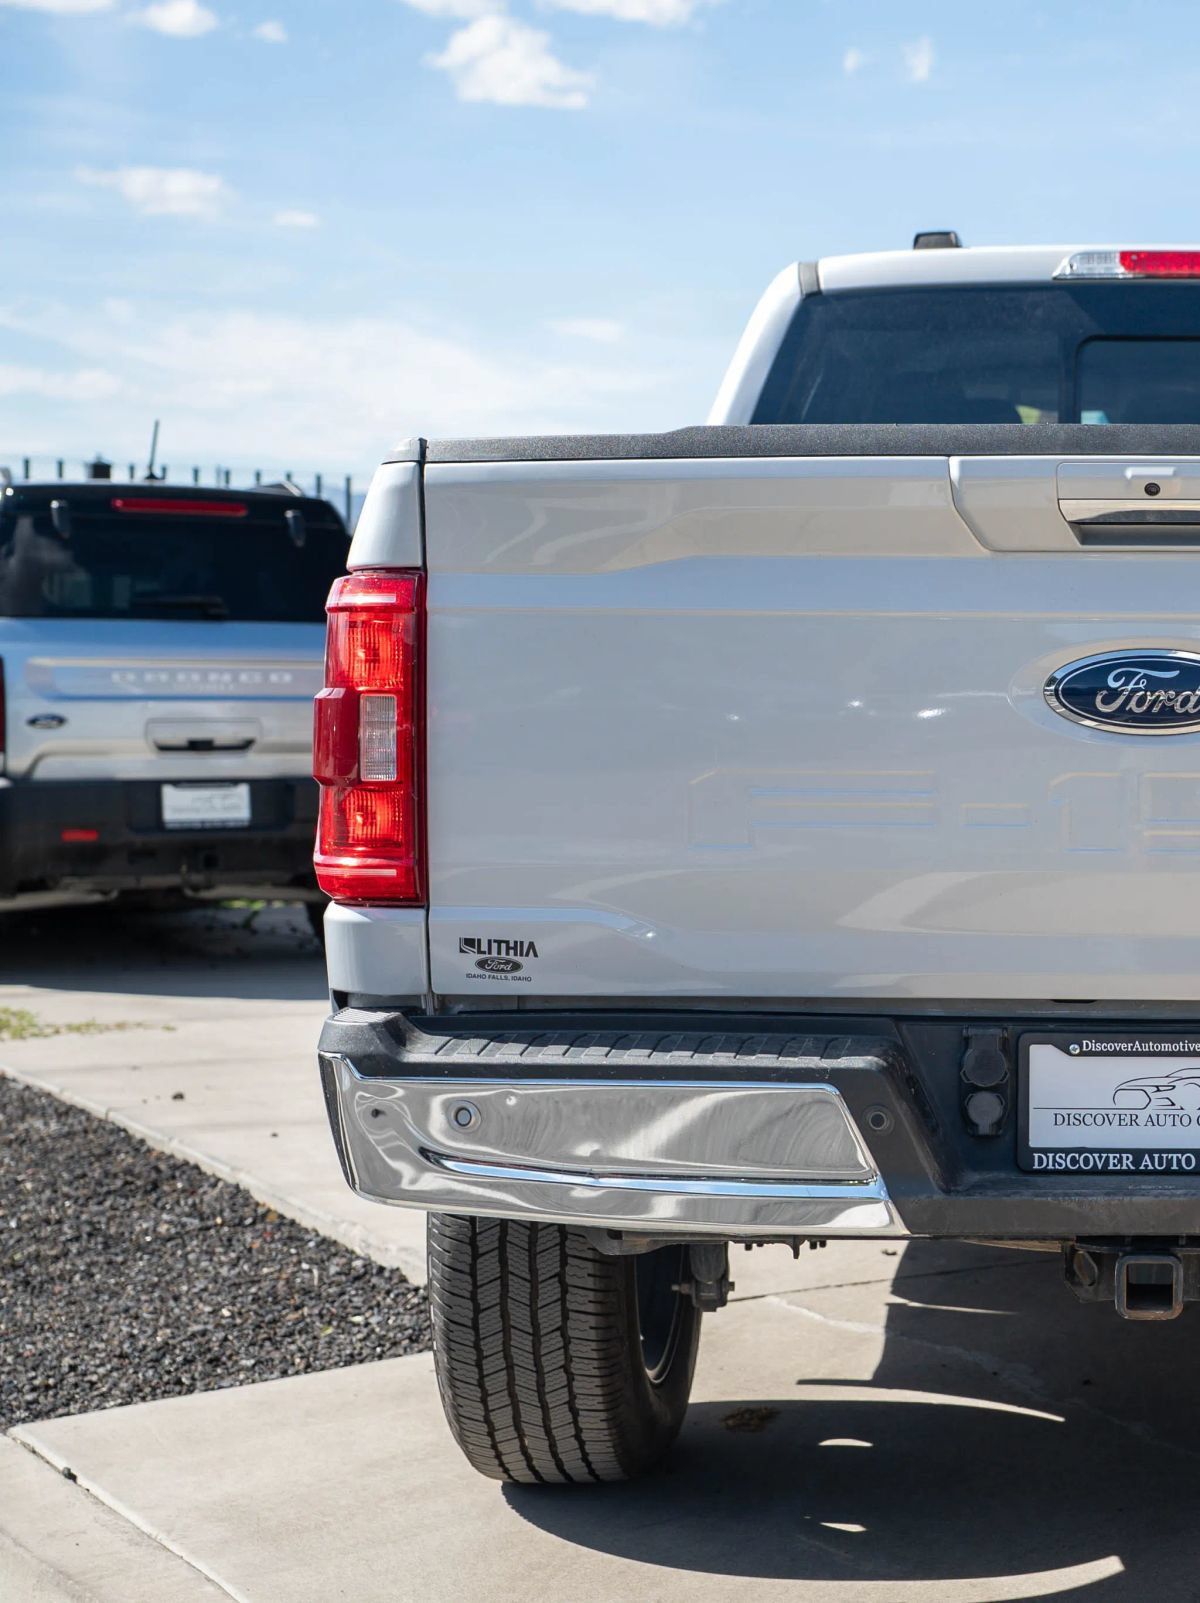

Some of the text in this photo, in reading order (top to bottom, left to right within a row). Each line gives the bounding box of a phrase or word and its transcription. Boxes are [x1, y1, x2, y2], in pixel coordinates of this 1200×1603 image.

[477, 938, 538, 958] LITHIA
[484, 958, 512, 971] Ford
[1053, 1112, 1140, 1127] DISCOVER
[1144, 1113, 1192, 1128] AUTO
[1033, 1153, 1135, 1170] DISCOVER
[1140, 1153, 1195, 1170] AUTO
